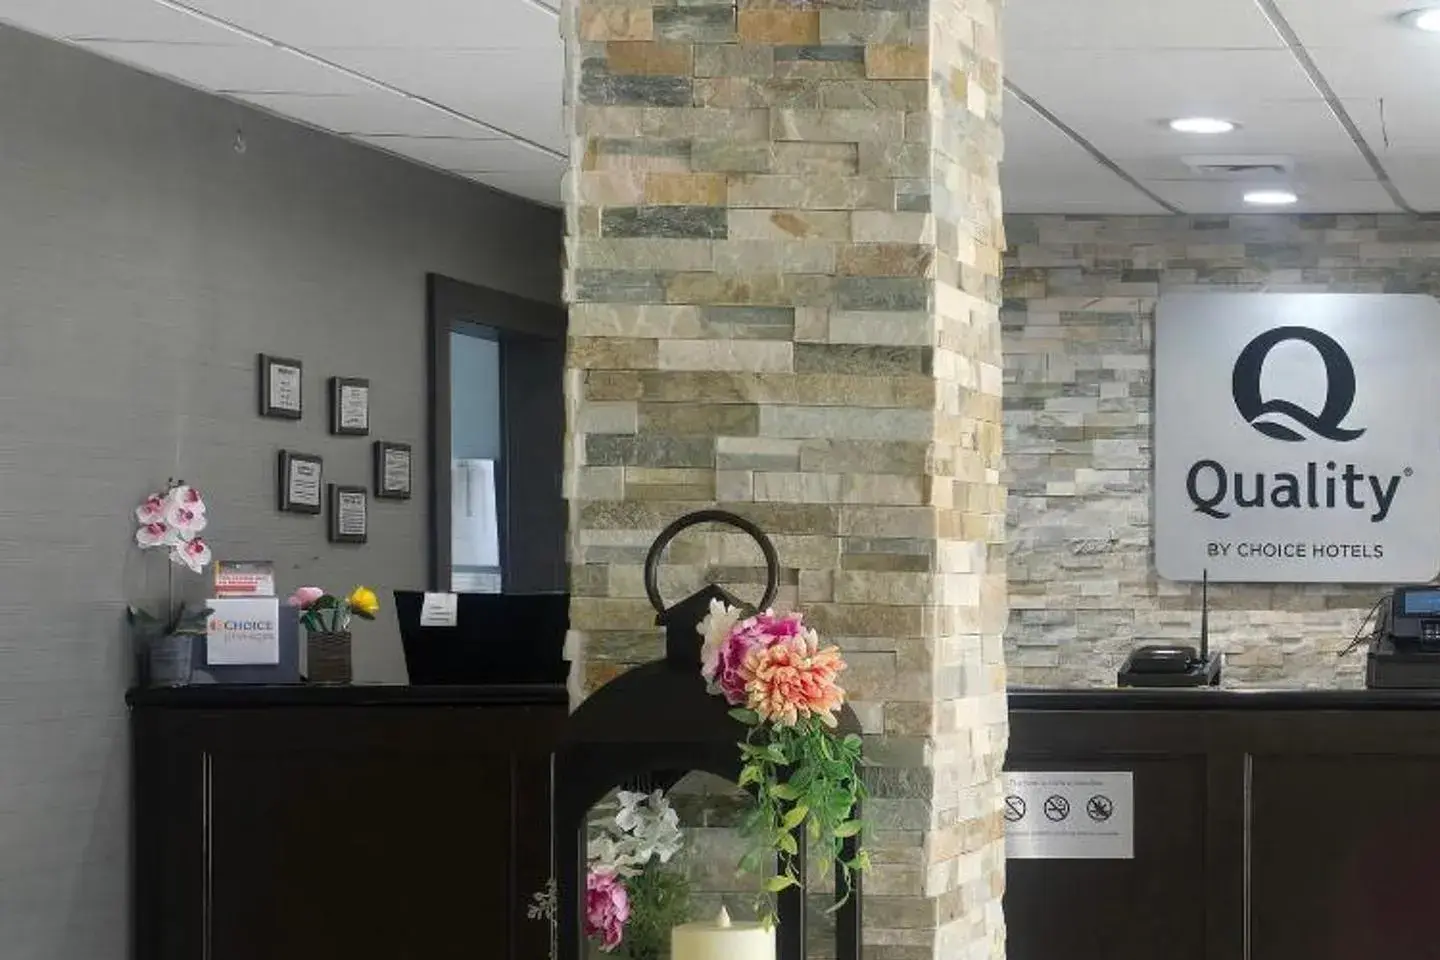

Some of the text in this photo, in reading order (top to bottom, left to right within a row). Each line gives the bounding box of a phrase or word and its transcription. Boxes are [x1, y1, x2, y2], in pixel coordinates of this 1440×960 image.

[1232, 325, 1367, 441] Q
[1186, 459, 1401, 522] Quality
[1207, 543, 1383, 558] BY CHOICE HOTELS
